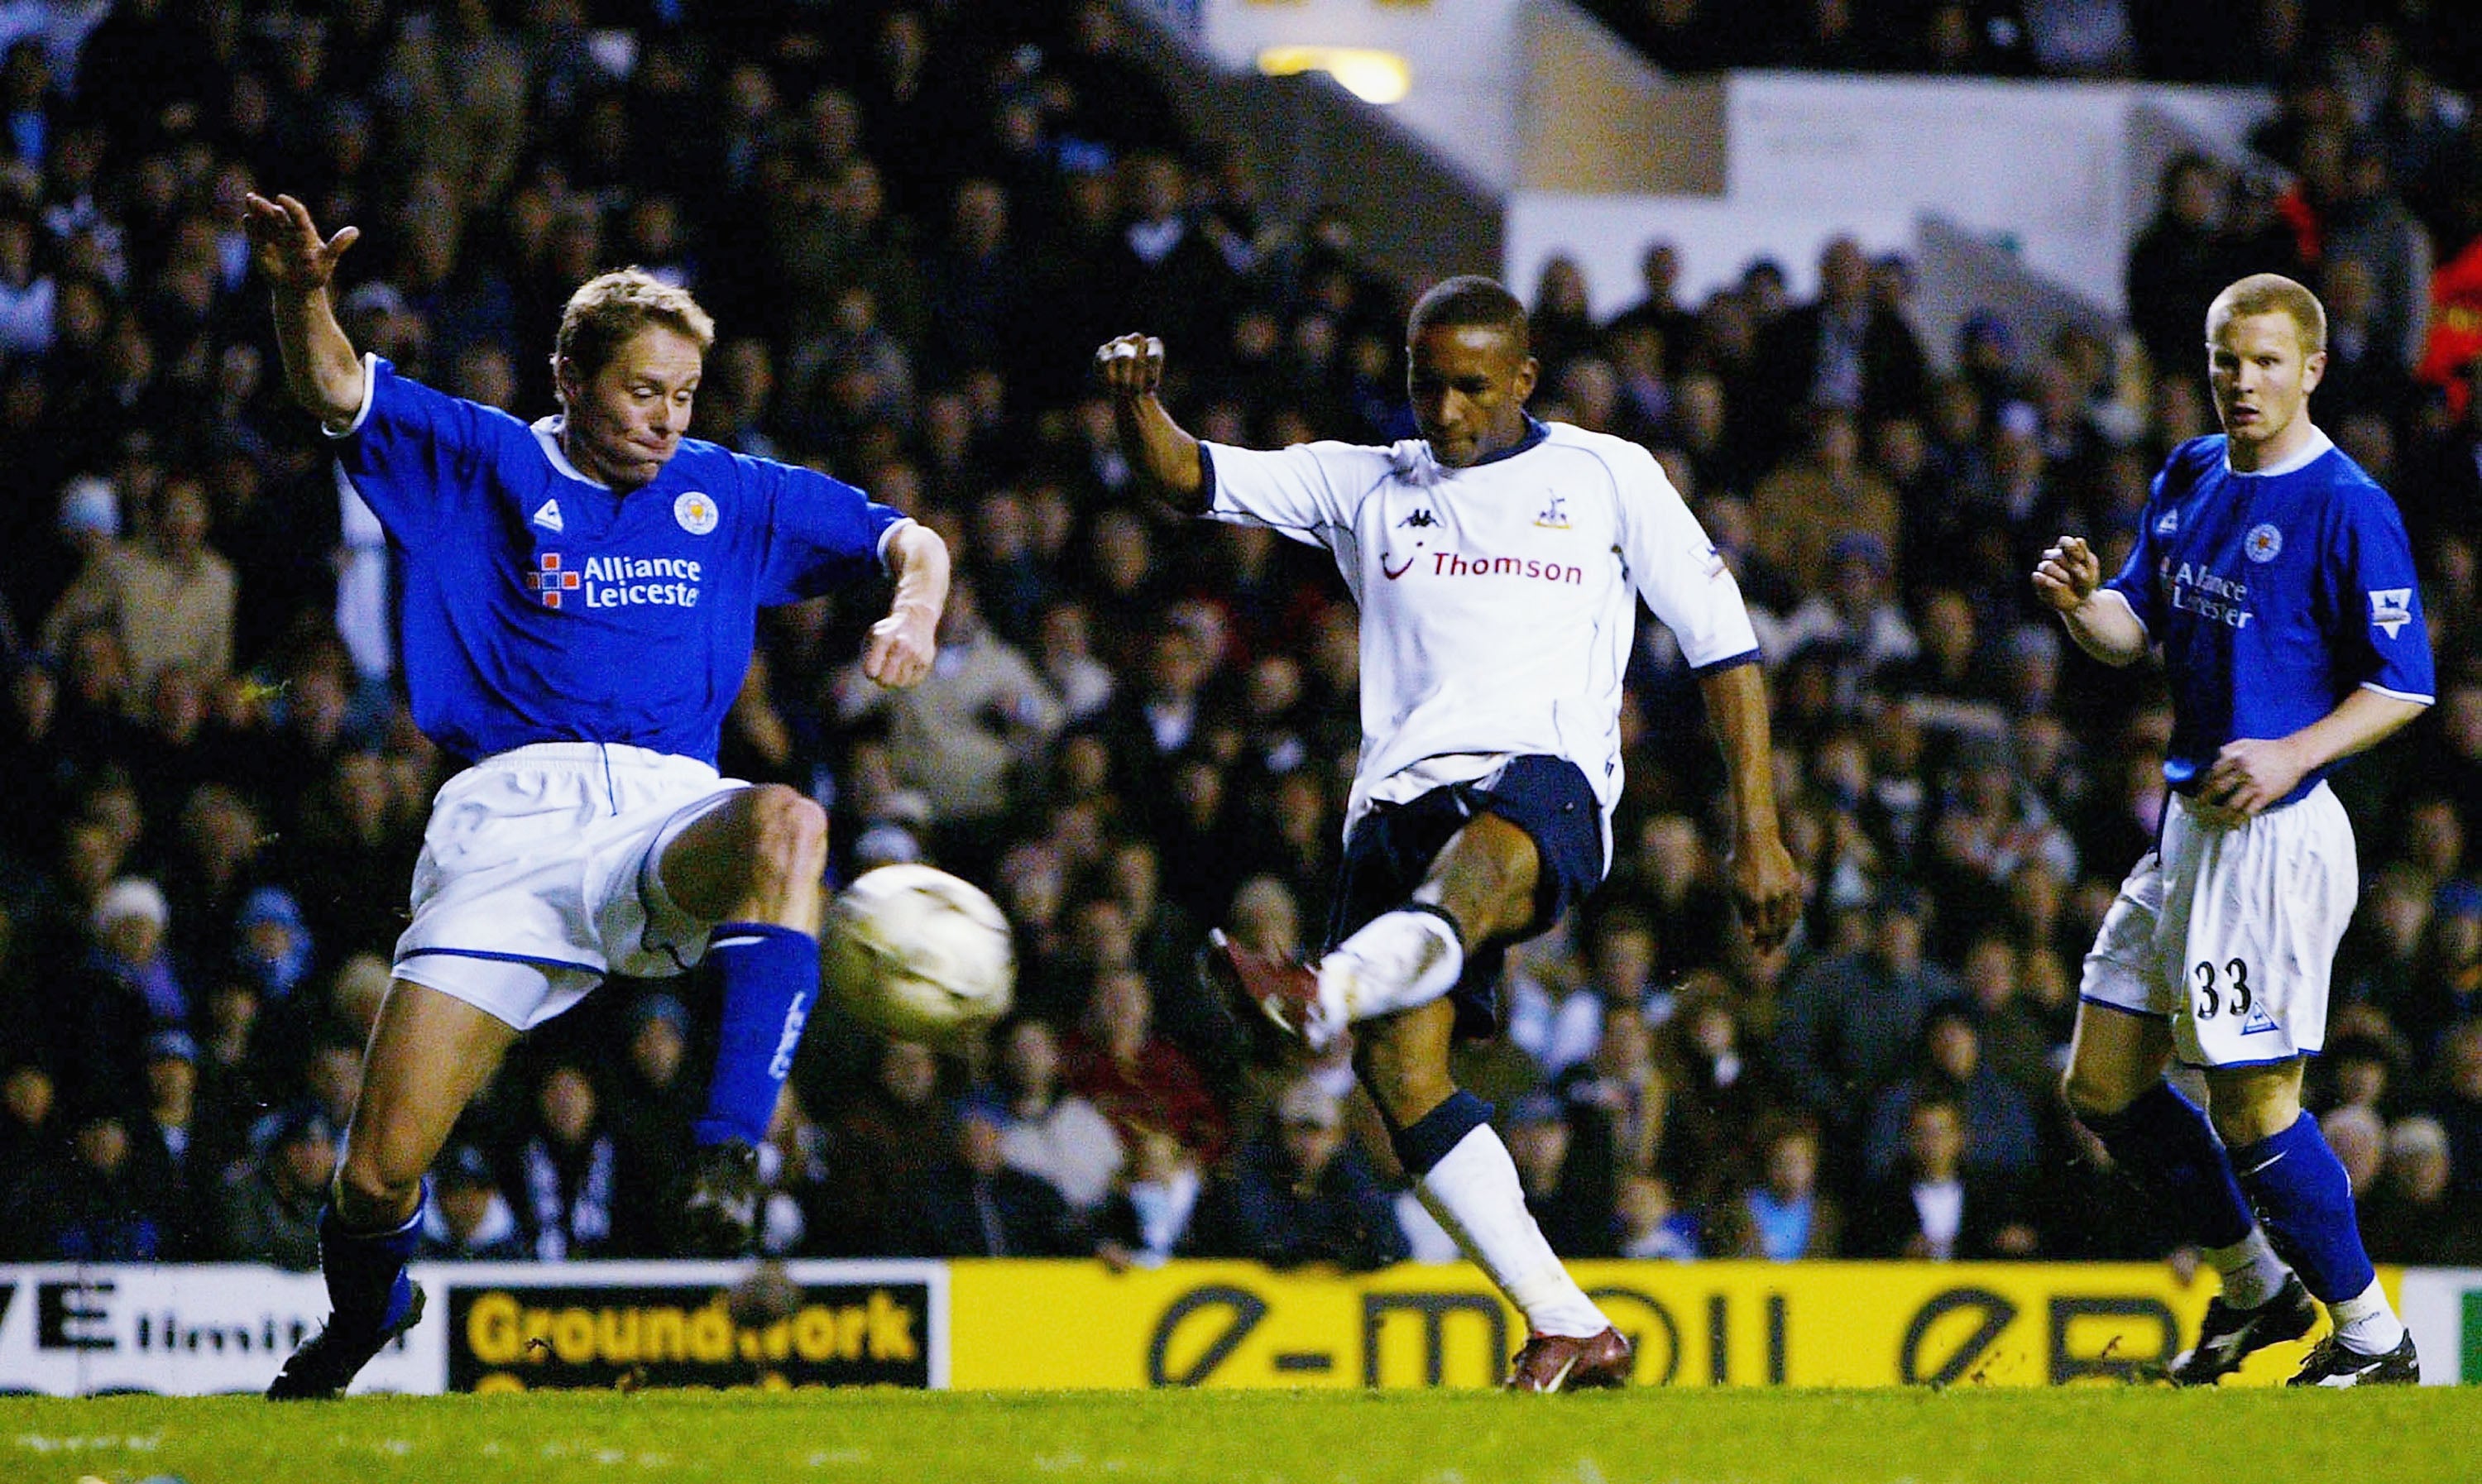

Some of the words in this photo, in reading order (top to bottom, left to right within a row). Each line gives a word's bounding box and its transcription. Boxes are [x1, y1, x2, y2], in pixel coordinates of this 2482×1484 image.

[583, 556, 702, 582] Alliance
[1433, 553, 1582, 585] Thomson
[585, 580, 700, 608] Leiceste
[2195, 957, 2251, 1021] 33
[0, 1282, 117, 1349] E
[137, 1311, 405, 1352] limit
